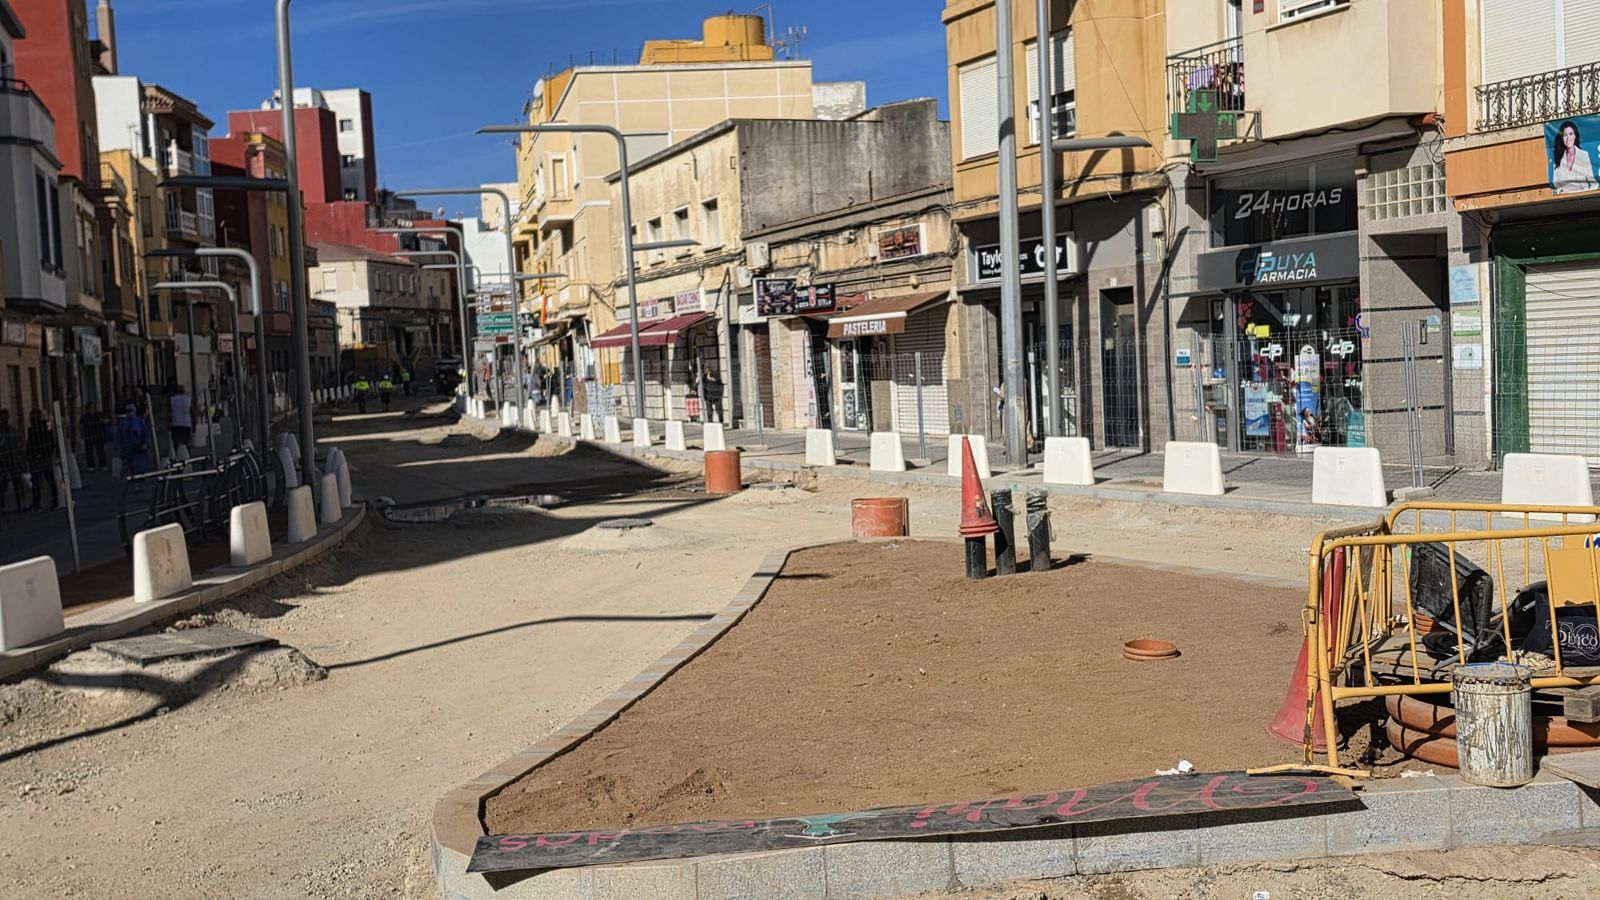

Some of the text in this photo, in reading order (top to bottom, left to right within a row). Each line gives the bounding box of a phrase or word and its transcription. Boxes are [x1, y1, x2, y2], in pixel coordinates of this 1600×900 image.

[1234, 188, 1343, 219] 24 HORAS
[981, 249, 1003, 268] Taylo
[843, 320, 887, 336] PASTELERIA
